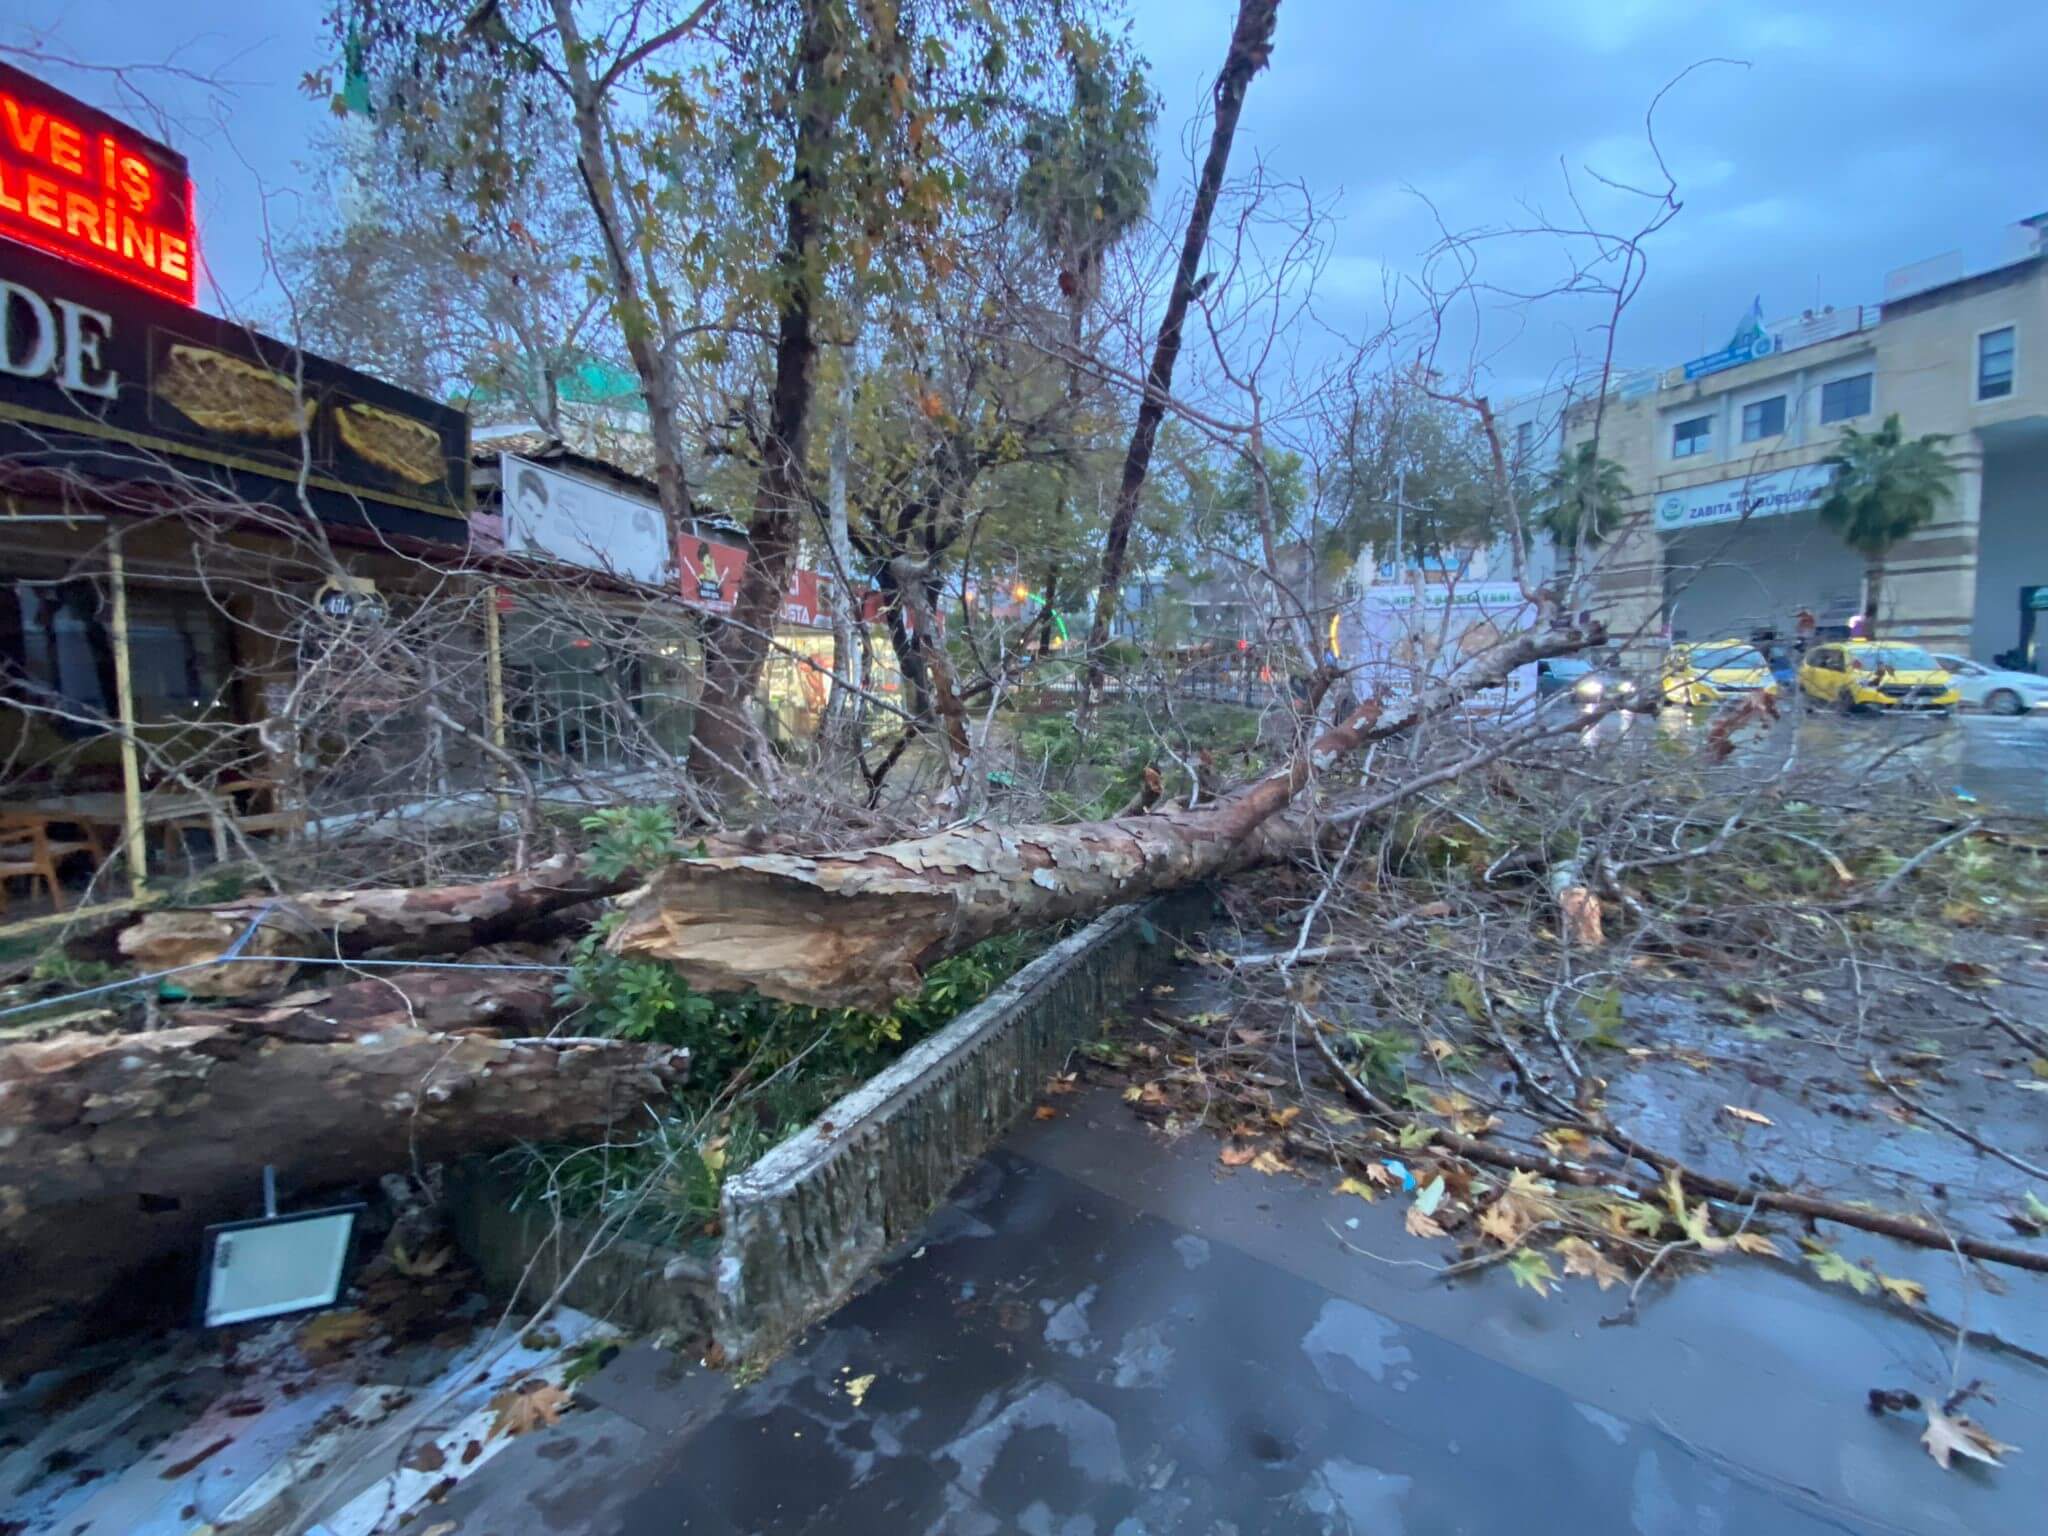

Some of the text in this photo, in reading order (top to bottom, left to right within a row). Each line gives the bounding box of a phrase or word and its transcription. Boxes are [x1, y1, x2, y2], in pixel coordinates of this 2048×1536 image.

[2, 98, 152, 213] VE İŞ
[0, 173, 189, 281] LERİNE
[0, 278, 119, 400] DE
[1689, 502, 1733, 520] ZABITA
